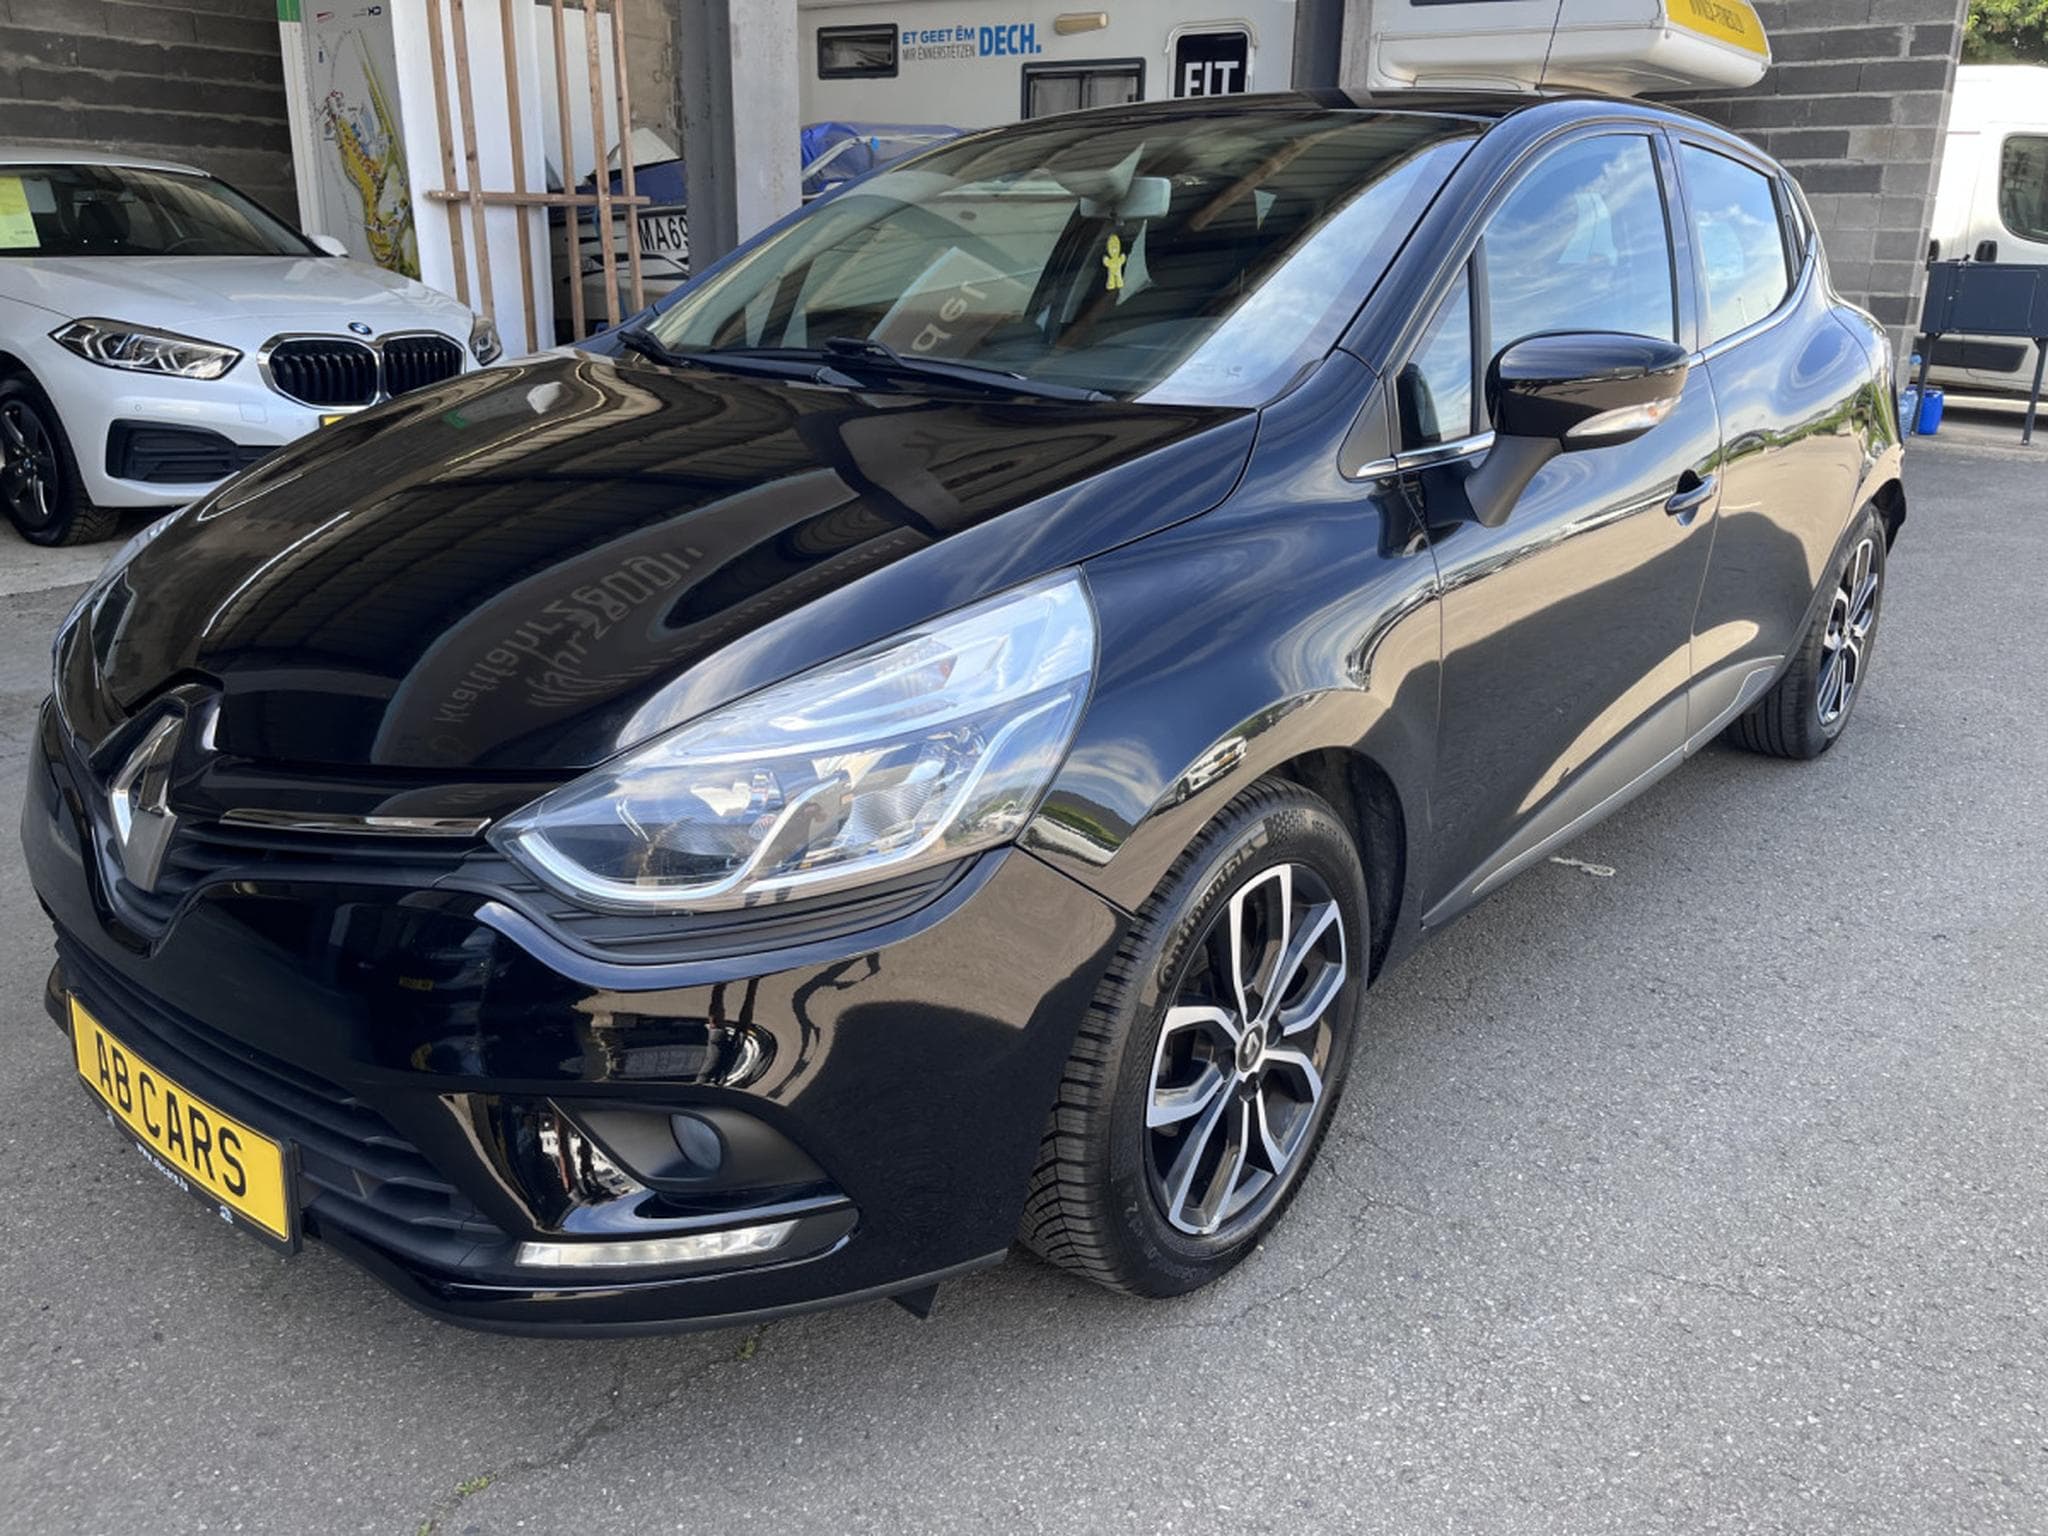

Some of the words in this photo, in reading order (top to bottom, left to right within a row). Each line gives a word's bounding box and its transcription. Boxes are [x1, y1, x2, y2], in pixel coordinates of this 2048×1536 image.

[902, 31, 918, 44] ET
[920, 29, 953, 43] GEET
[979, 23, 1042, 56] DECH.
[1184, 61, 1239, 97] FIT
[96, 1031, 132, 1114] AB
[139, 1072, 247, 1197] CARS
